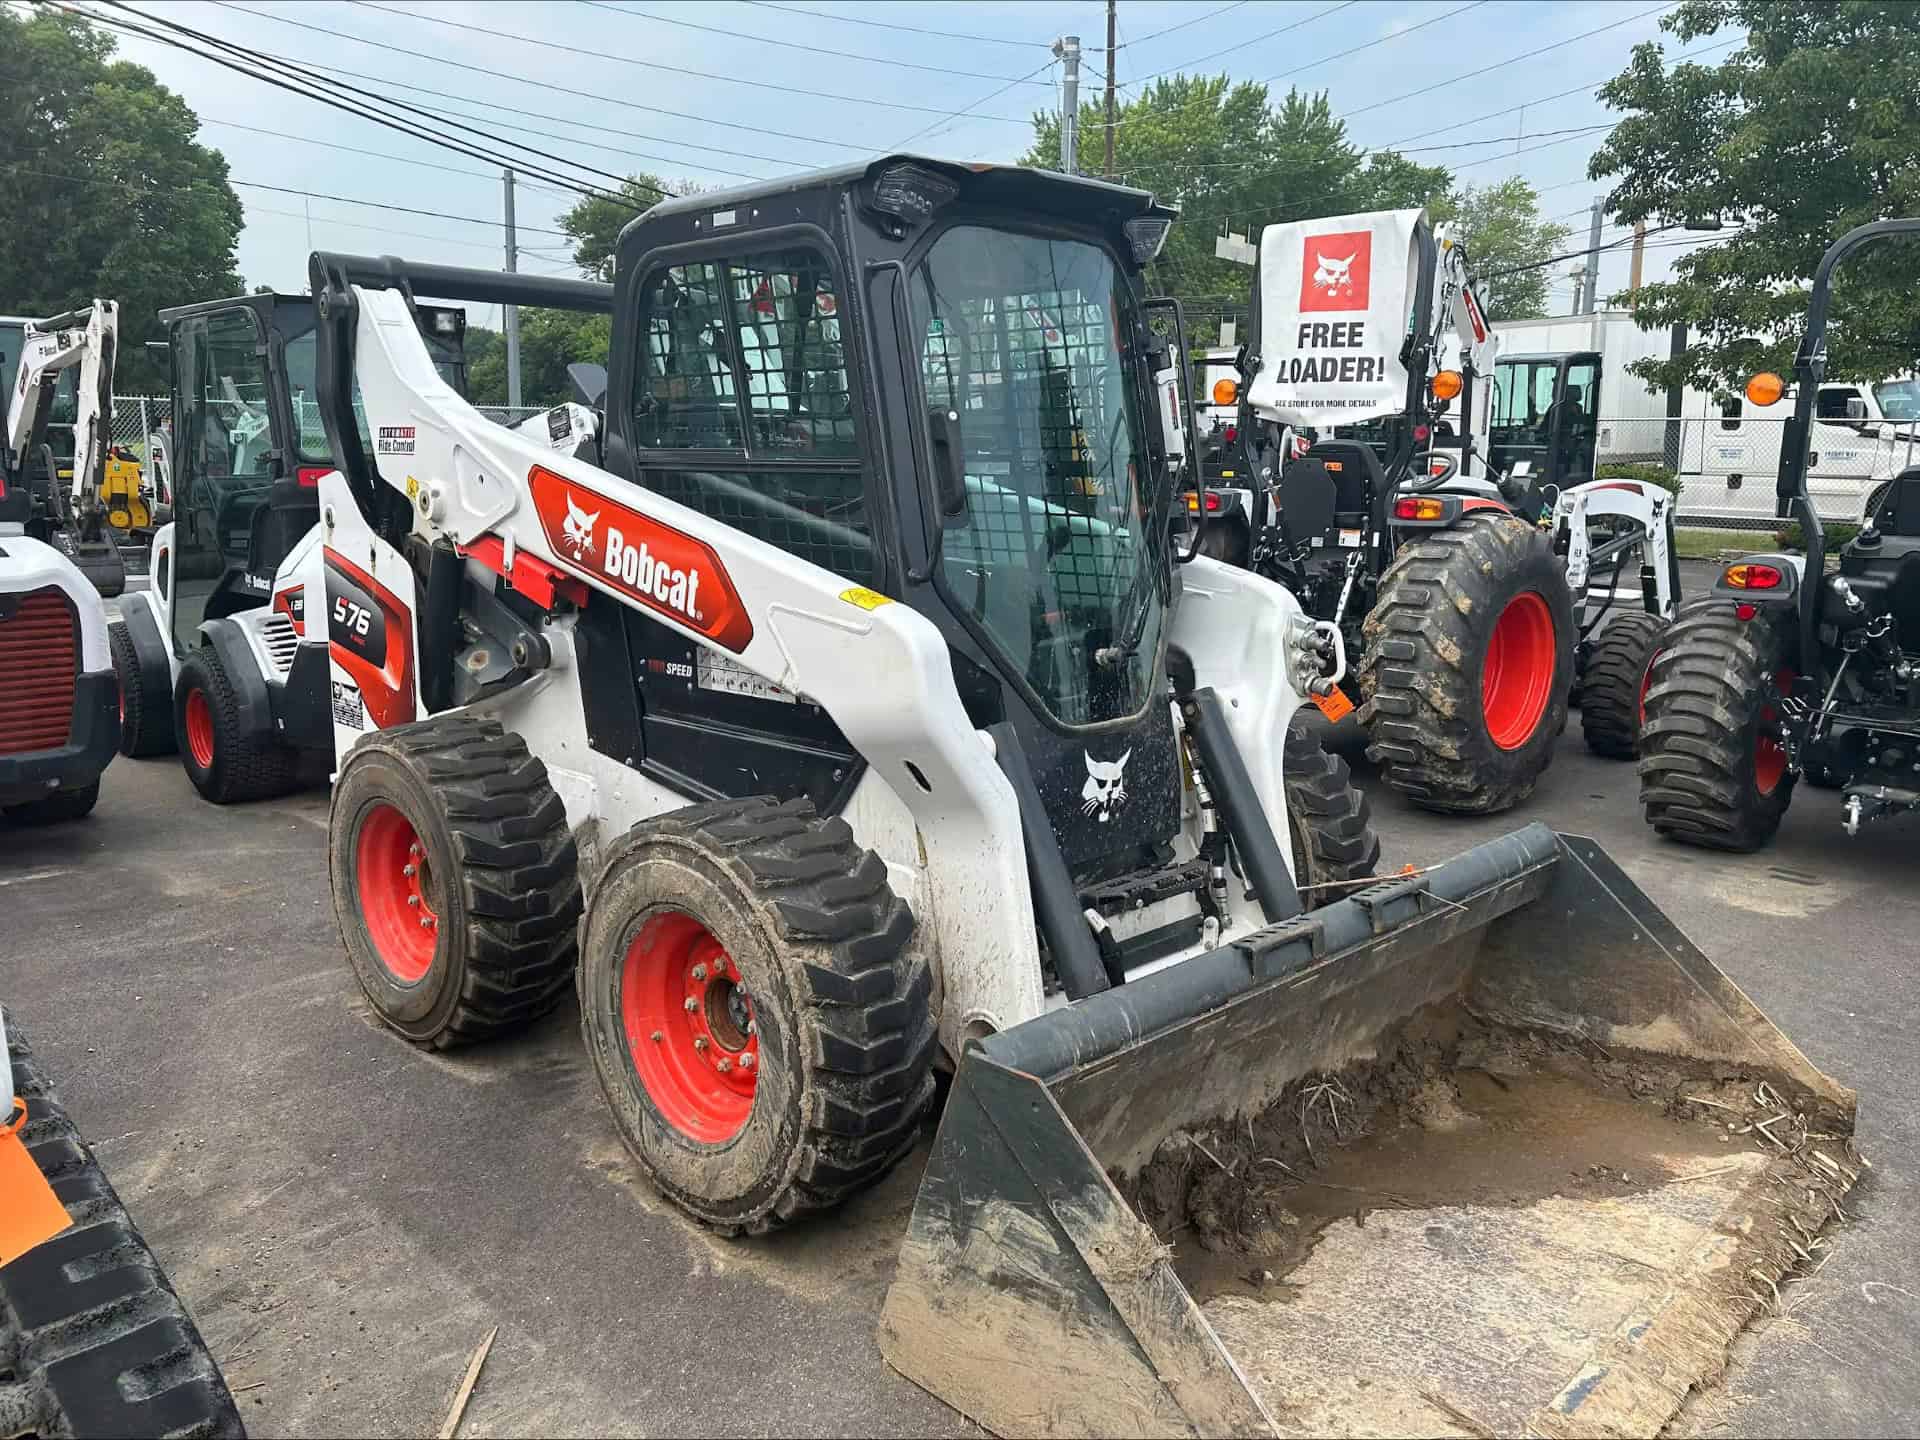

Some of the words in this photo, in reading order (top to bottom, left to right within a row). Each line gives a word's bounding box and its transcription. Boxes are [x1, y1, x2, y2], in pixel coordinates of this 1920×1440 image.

[1297, 321, 1365, 349] FREE
[1276, 356, 1385, 384] LOADER!
[1287, 399, 1309, 408] STORE
[1311, 399, 1325, 408] FOR
[1326, 399, 1347, 408] MORE
[1348, 399, 1377, 408] DETAILS
[378, 439, 391, 452] Ride
[392, 439, 415, 452] Control
[604, 526, 700, 619] Bobcat
[333, 596, 371, 636] S76
[666, 662, 693, 678] SPEED
